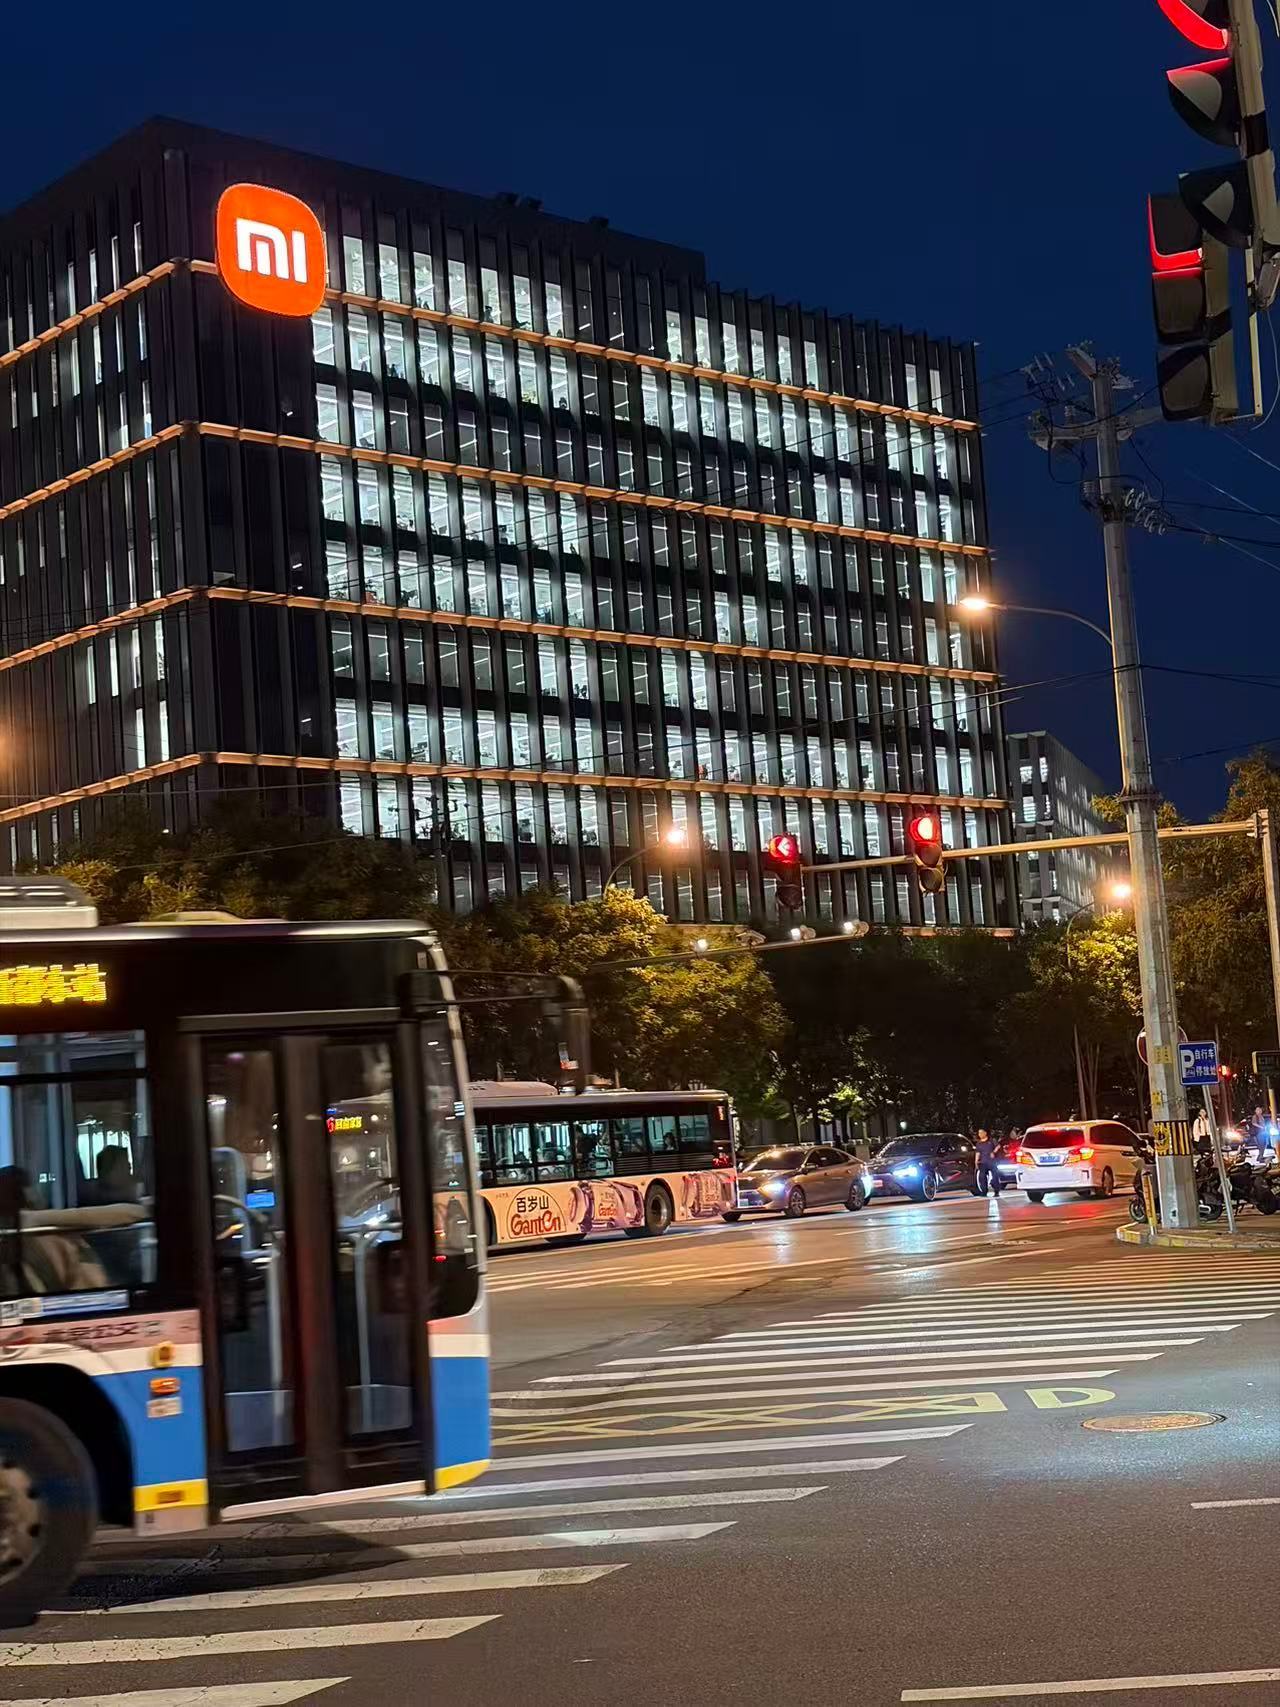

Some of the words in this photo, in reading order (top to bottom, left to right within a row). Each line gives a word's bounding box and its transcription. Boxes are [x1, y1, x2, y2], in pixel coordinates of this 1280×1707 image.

[1194, 1048, 1216, 1060] 自行车
[1180, 1049, 1195, 1078] P
[1195, 1065, 1217, 1077] 停放处
[516, 1195, 550, 1213] 百岁山
